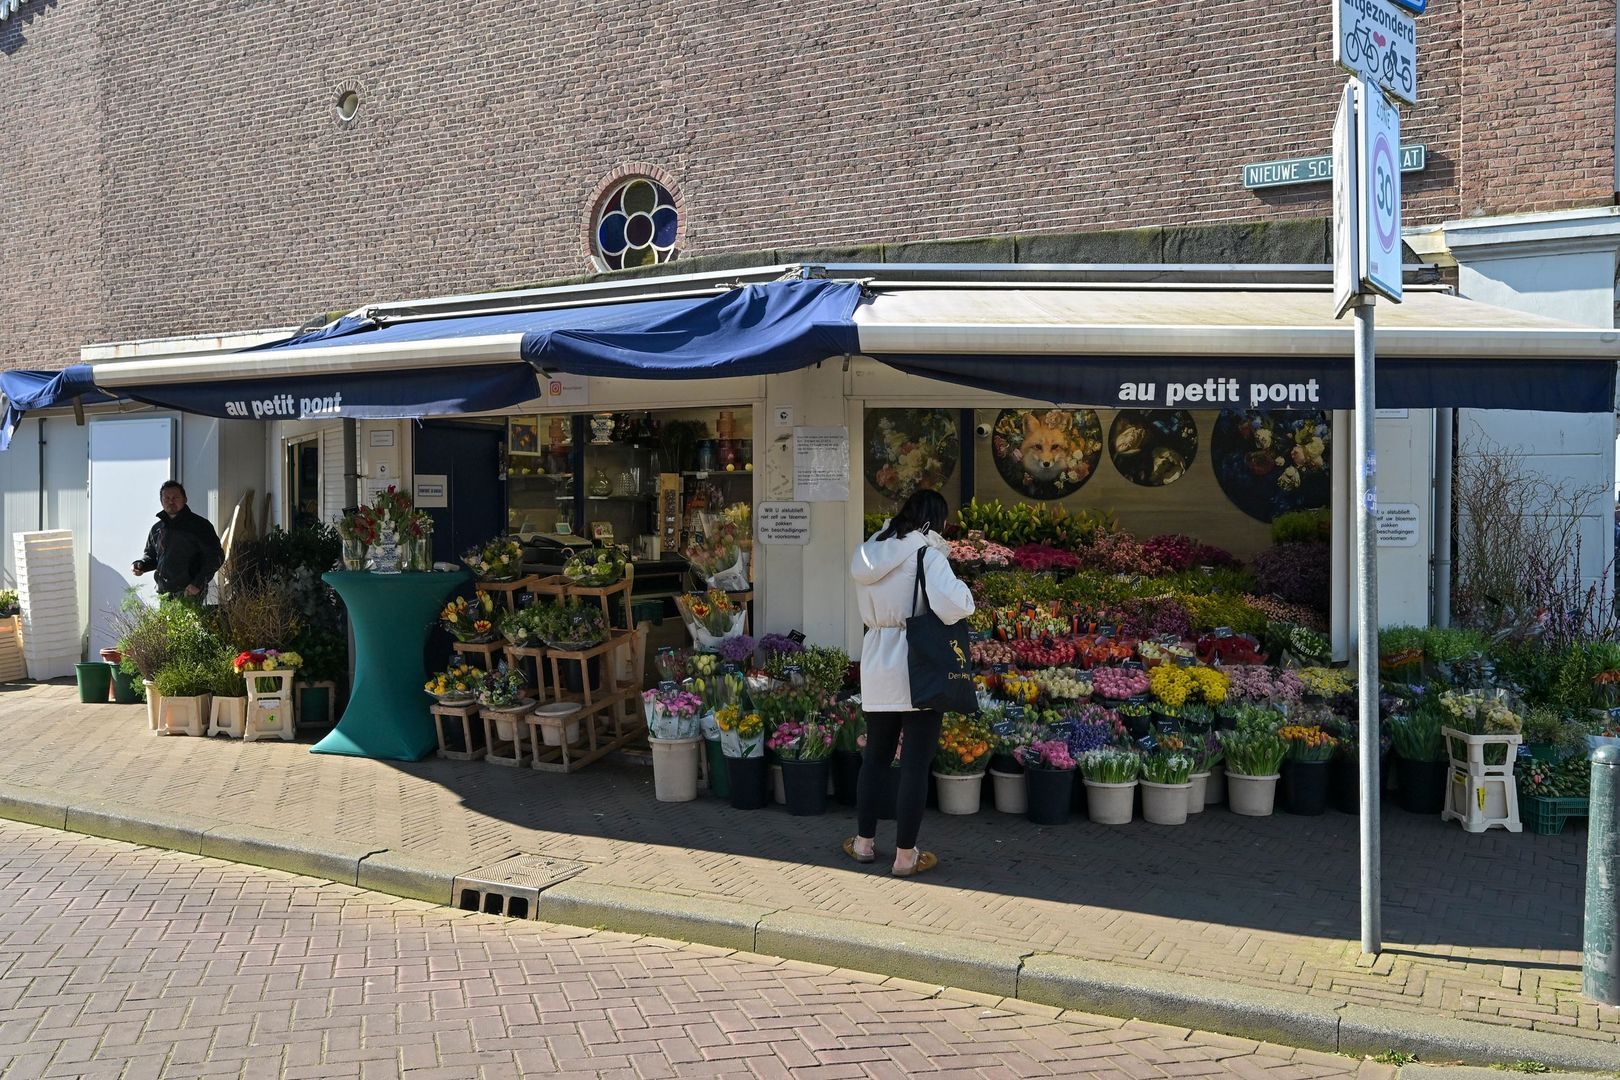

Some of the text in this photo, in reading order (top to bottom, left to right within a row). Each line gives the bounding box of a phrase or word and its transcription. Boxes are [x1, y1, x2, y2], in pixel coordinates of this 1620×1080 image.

[1344, 0, 1414, 45] gezonderd
[1250, 163, 1300, 183] NIEUWE
[1377, 165, 1393, 217] 30
[224, 391, 342, 419] au petit pont
[1118, 377, 1320, 408] au petit pont
